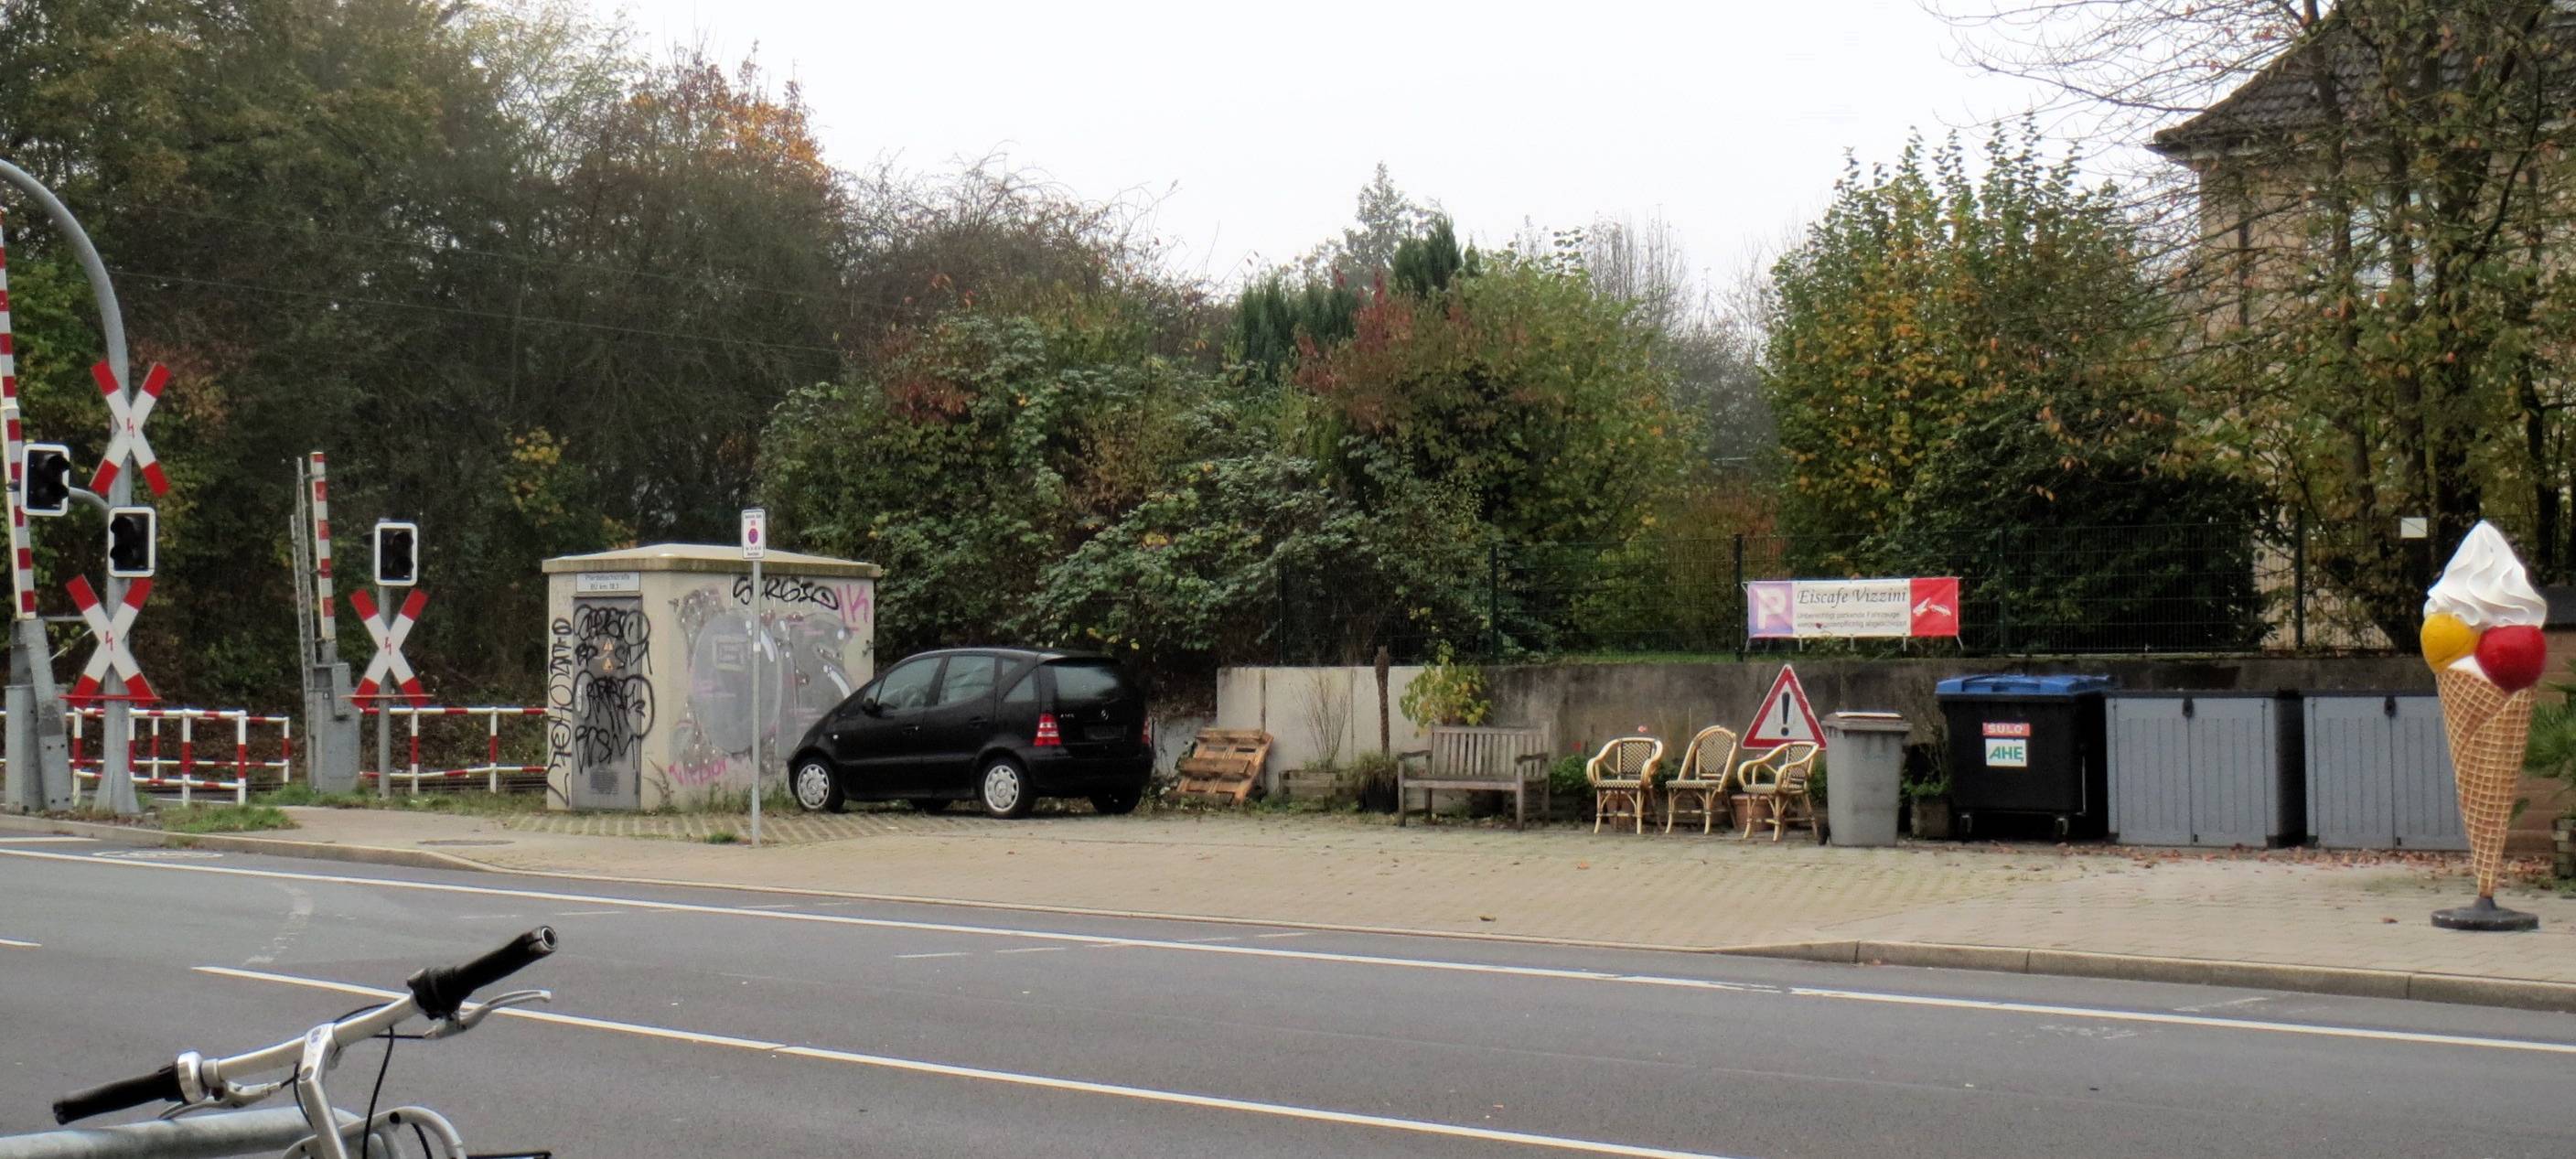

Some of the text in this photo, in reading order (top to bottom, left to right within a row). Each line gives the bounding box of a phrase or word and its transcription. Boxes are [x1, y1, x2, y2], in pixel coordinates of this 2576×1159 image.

[1798, 586, 1907, 608] Eiscafe Vizzini
[1988, 724, 2023, 734] SULO
[1989, 746, 2024, 762] AHE
